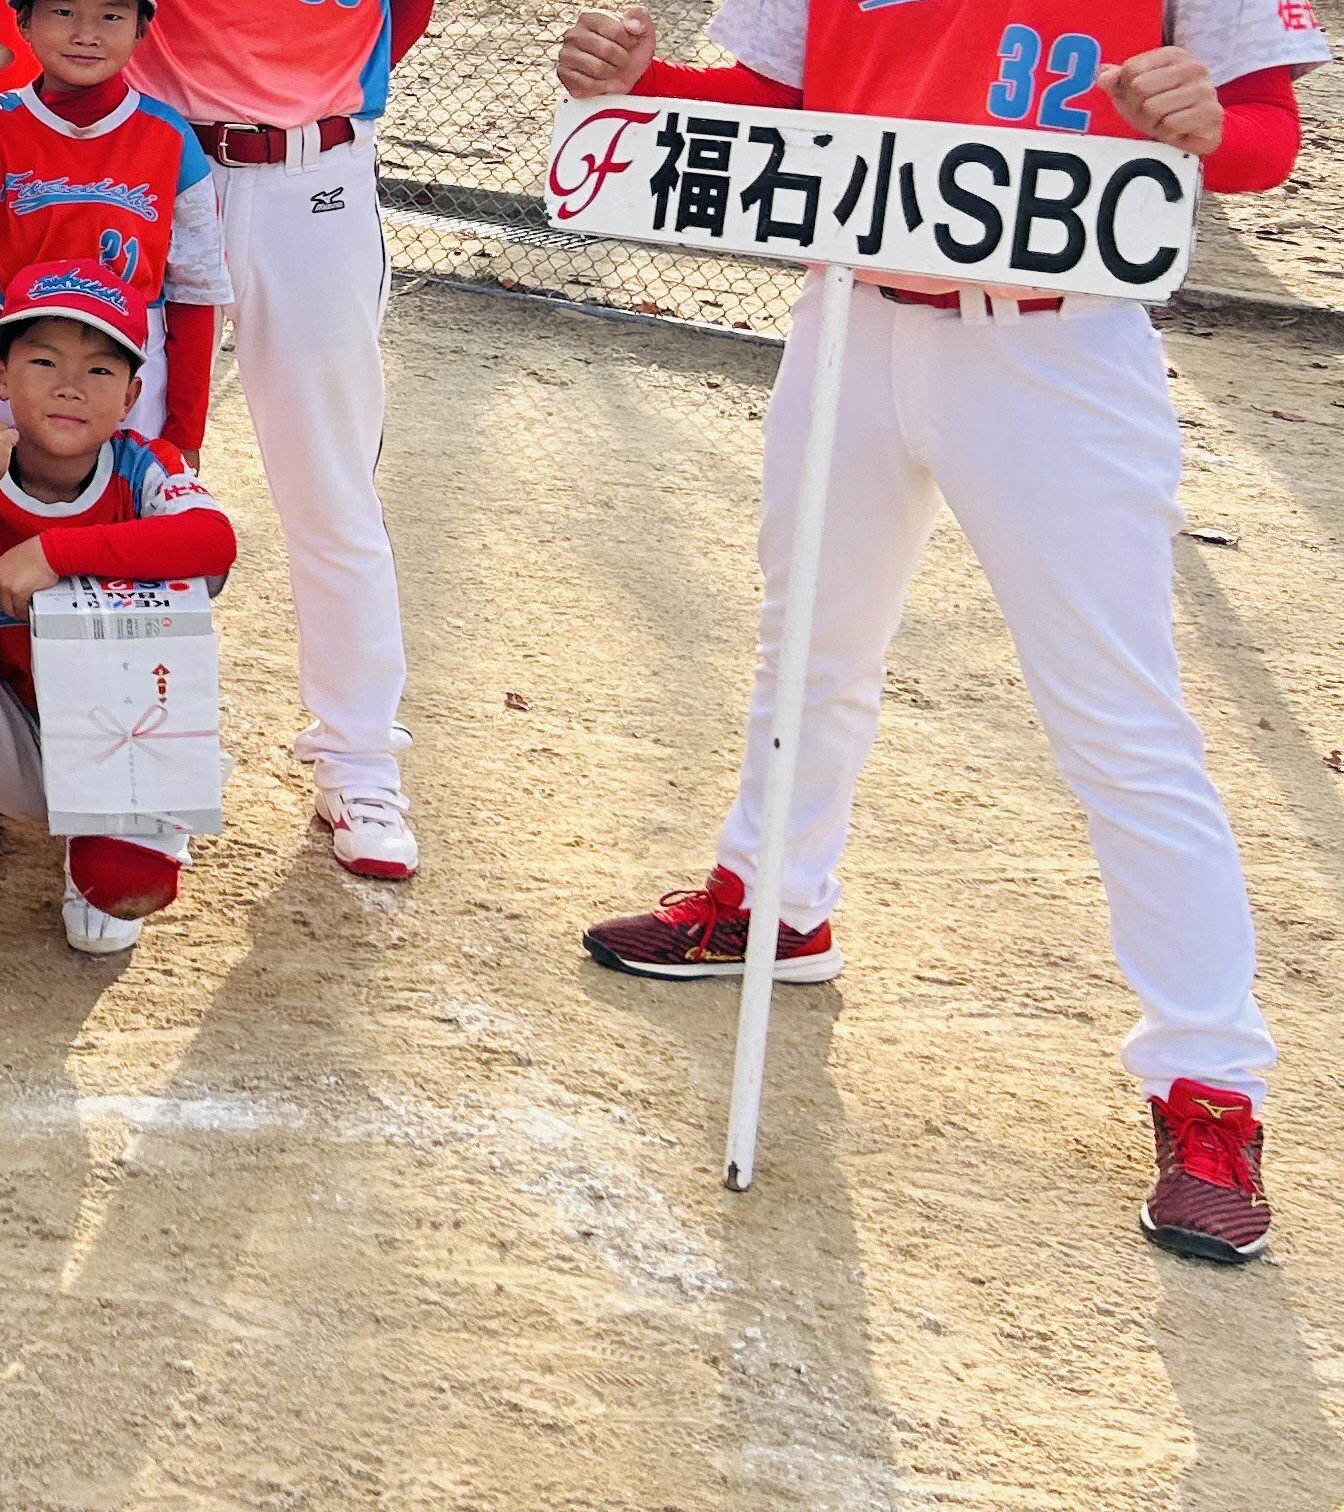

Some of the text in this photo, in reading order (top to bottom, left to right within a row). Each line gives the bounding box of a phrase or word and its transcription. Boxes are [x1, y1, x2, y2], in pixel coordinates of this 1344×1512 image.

[986, 23, 1103, 132] 32
[648, 111, 1185, 285] 福石小SBC
